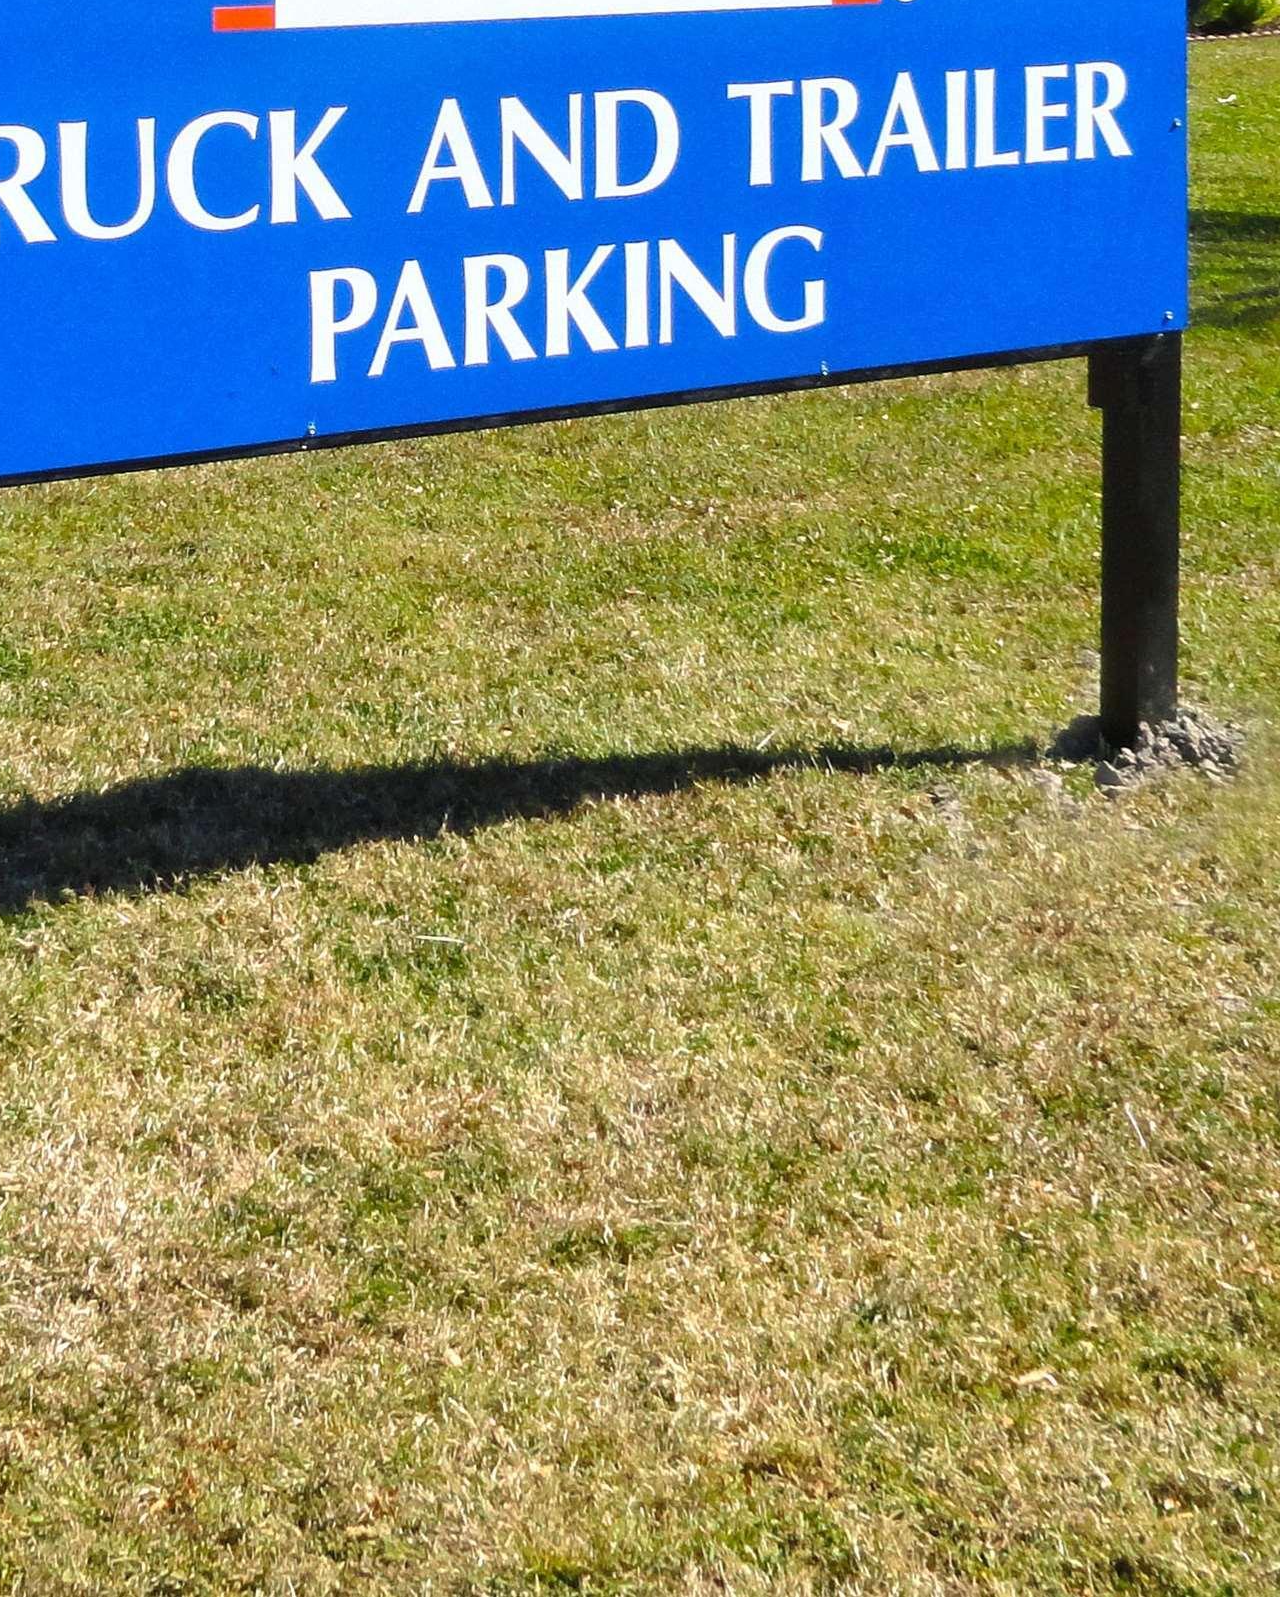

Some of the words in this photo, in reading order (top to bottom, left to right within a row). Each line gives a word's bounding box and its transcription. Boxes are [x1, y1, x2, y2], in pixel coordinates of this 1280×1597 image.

[405, 88, 680, 214] AND
[726, 60, 1133, 187] TRAILER
[308, 224, 825, 384] PARKING
